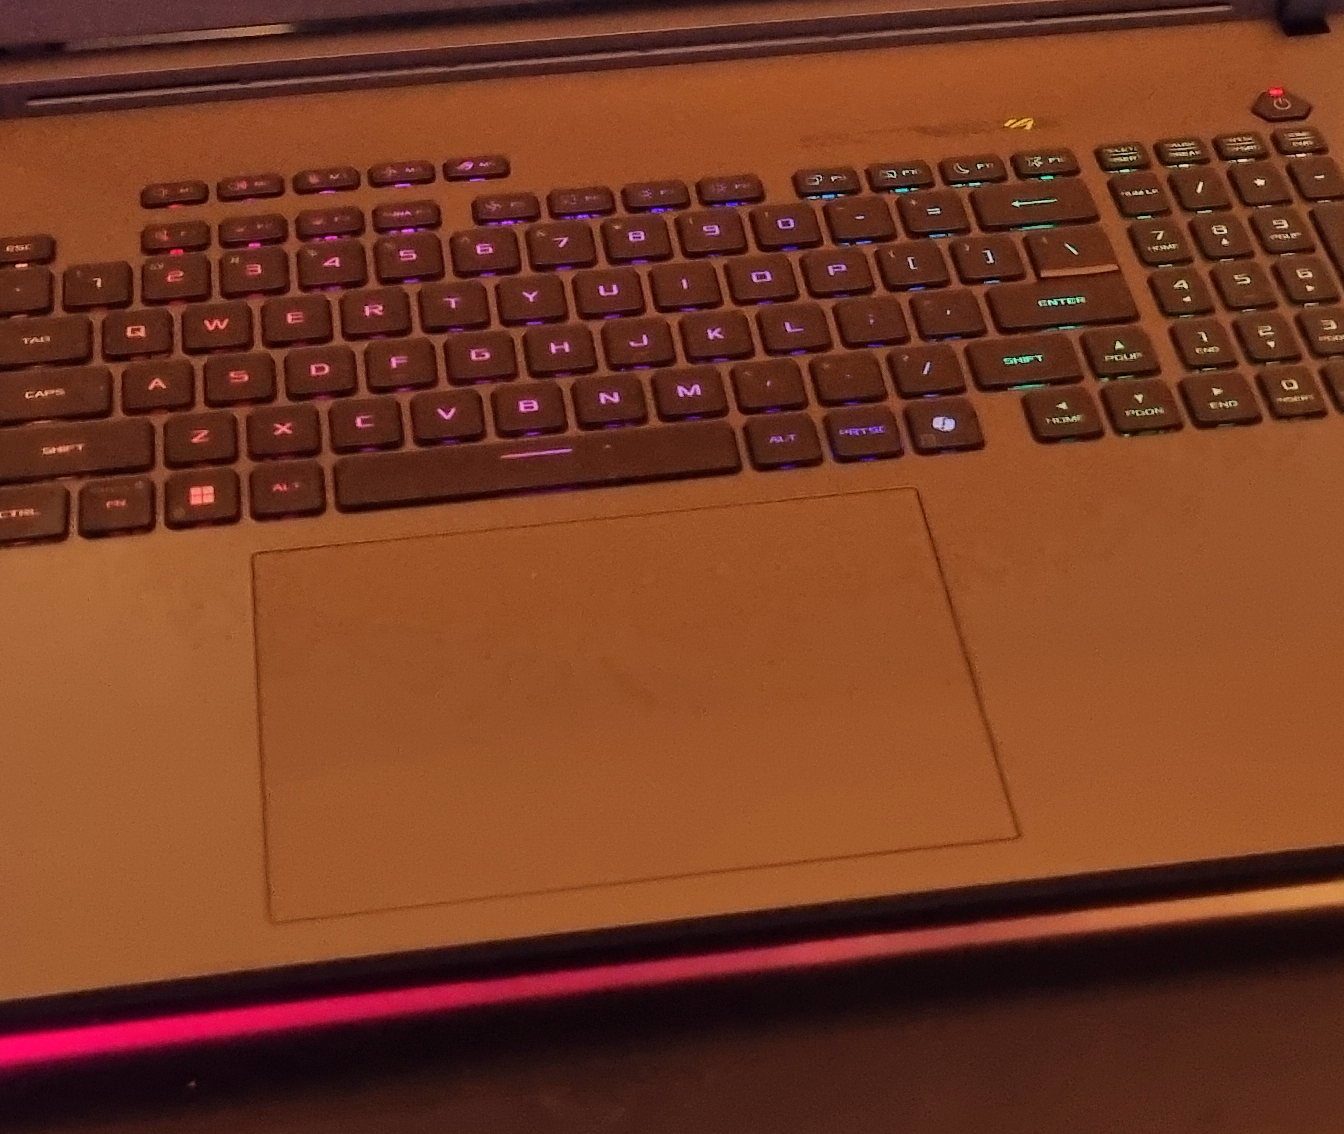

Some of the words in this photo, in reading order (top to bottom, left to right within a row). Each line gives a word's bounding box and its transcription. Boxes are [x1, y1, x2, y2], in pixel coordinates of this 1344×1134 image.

[1037, 296, 1086, 307] ENTER
[286, 311, 304, 325] E
[203, 317, 229, 332] W
[24, 388, 66, 399] CAPS
